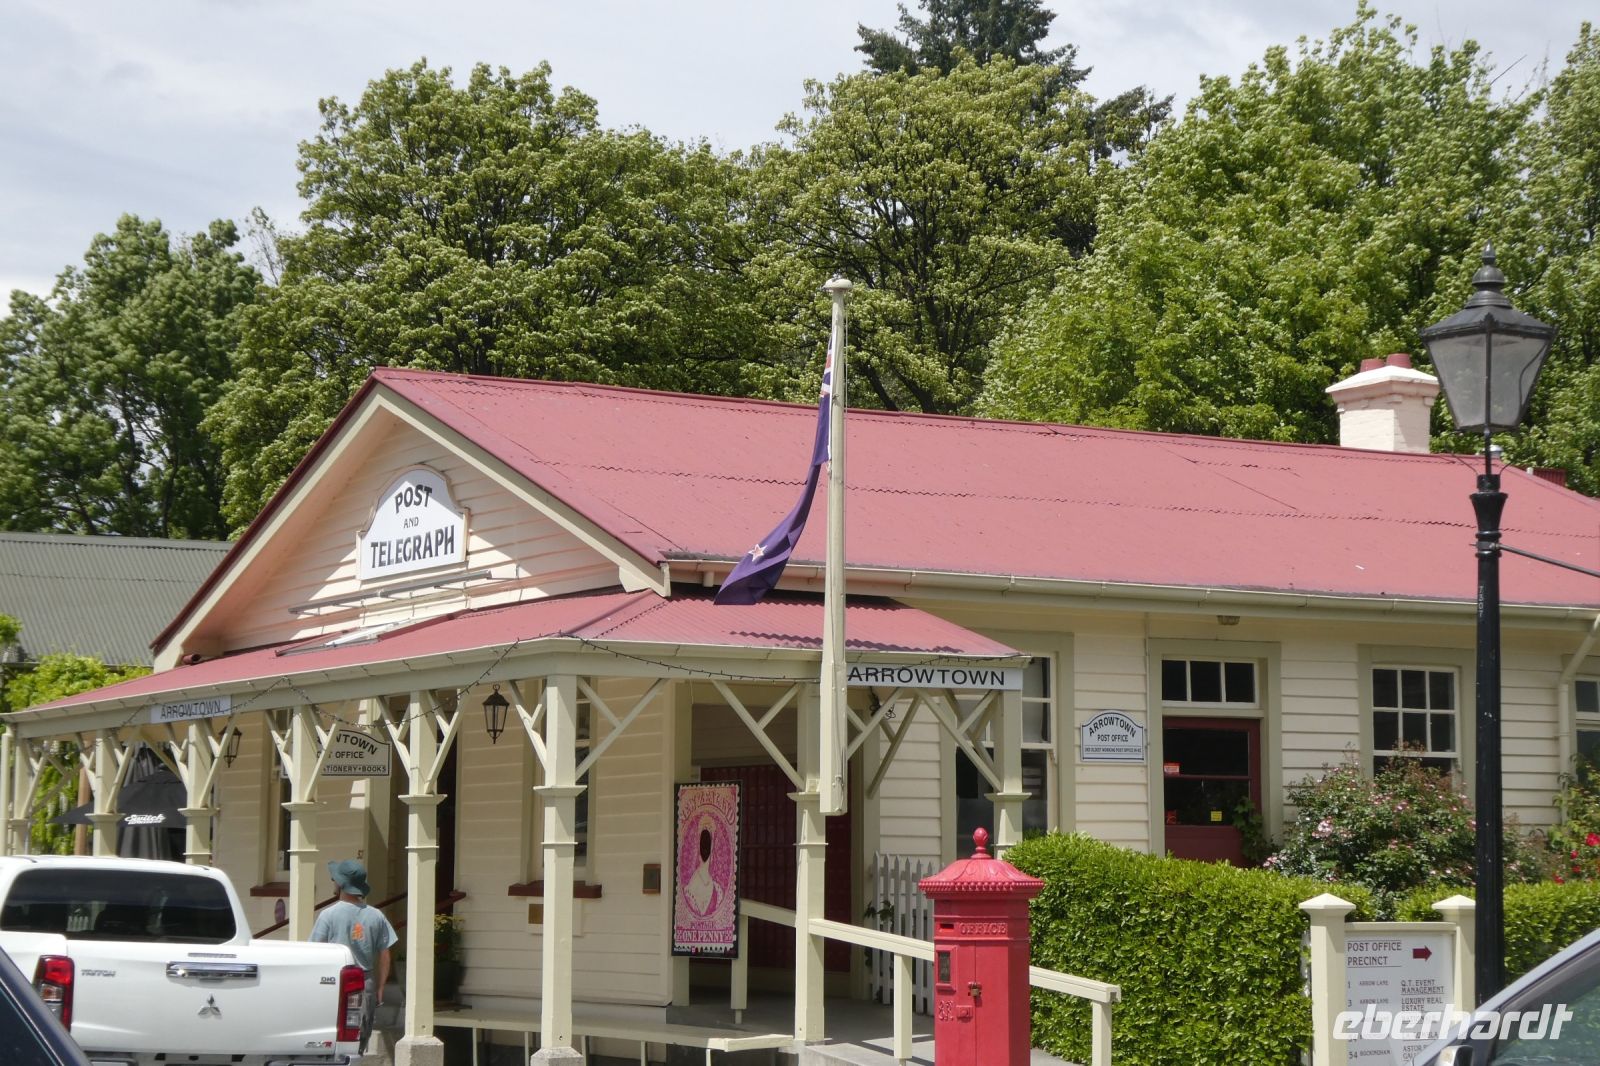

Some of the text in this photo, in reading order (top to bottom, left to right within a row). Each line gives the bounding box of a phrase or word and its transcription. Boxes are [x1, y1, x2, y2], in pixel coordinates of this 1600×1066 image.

[395, 484, 432, 514] POST
[403, 517, 419, 528] AND
[370, 525, 455, 568] TELEGRAPH
[848, 667, 1005, 686] ARROWTOWN
[160, 700, 221, 720] ARROWTOWN
[1089, 716, 1136, 737] ARROWTOWN
[1097, 734, 1129, 742] POST OFFICE
[335, 751, 364, 759] OFFICE
[959, 922, 1007, 935] OFFICE
[682, 930, 725, 942] ONE PENNY
[1347, 942, 1402, 952] POST OFFICE
[1347, 956, 1388, 966] PRECINCT
[1401, 986, 1444, 994] MANAGEMENT
